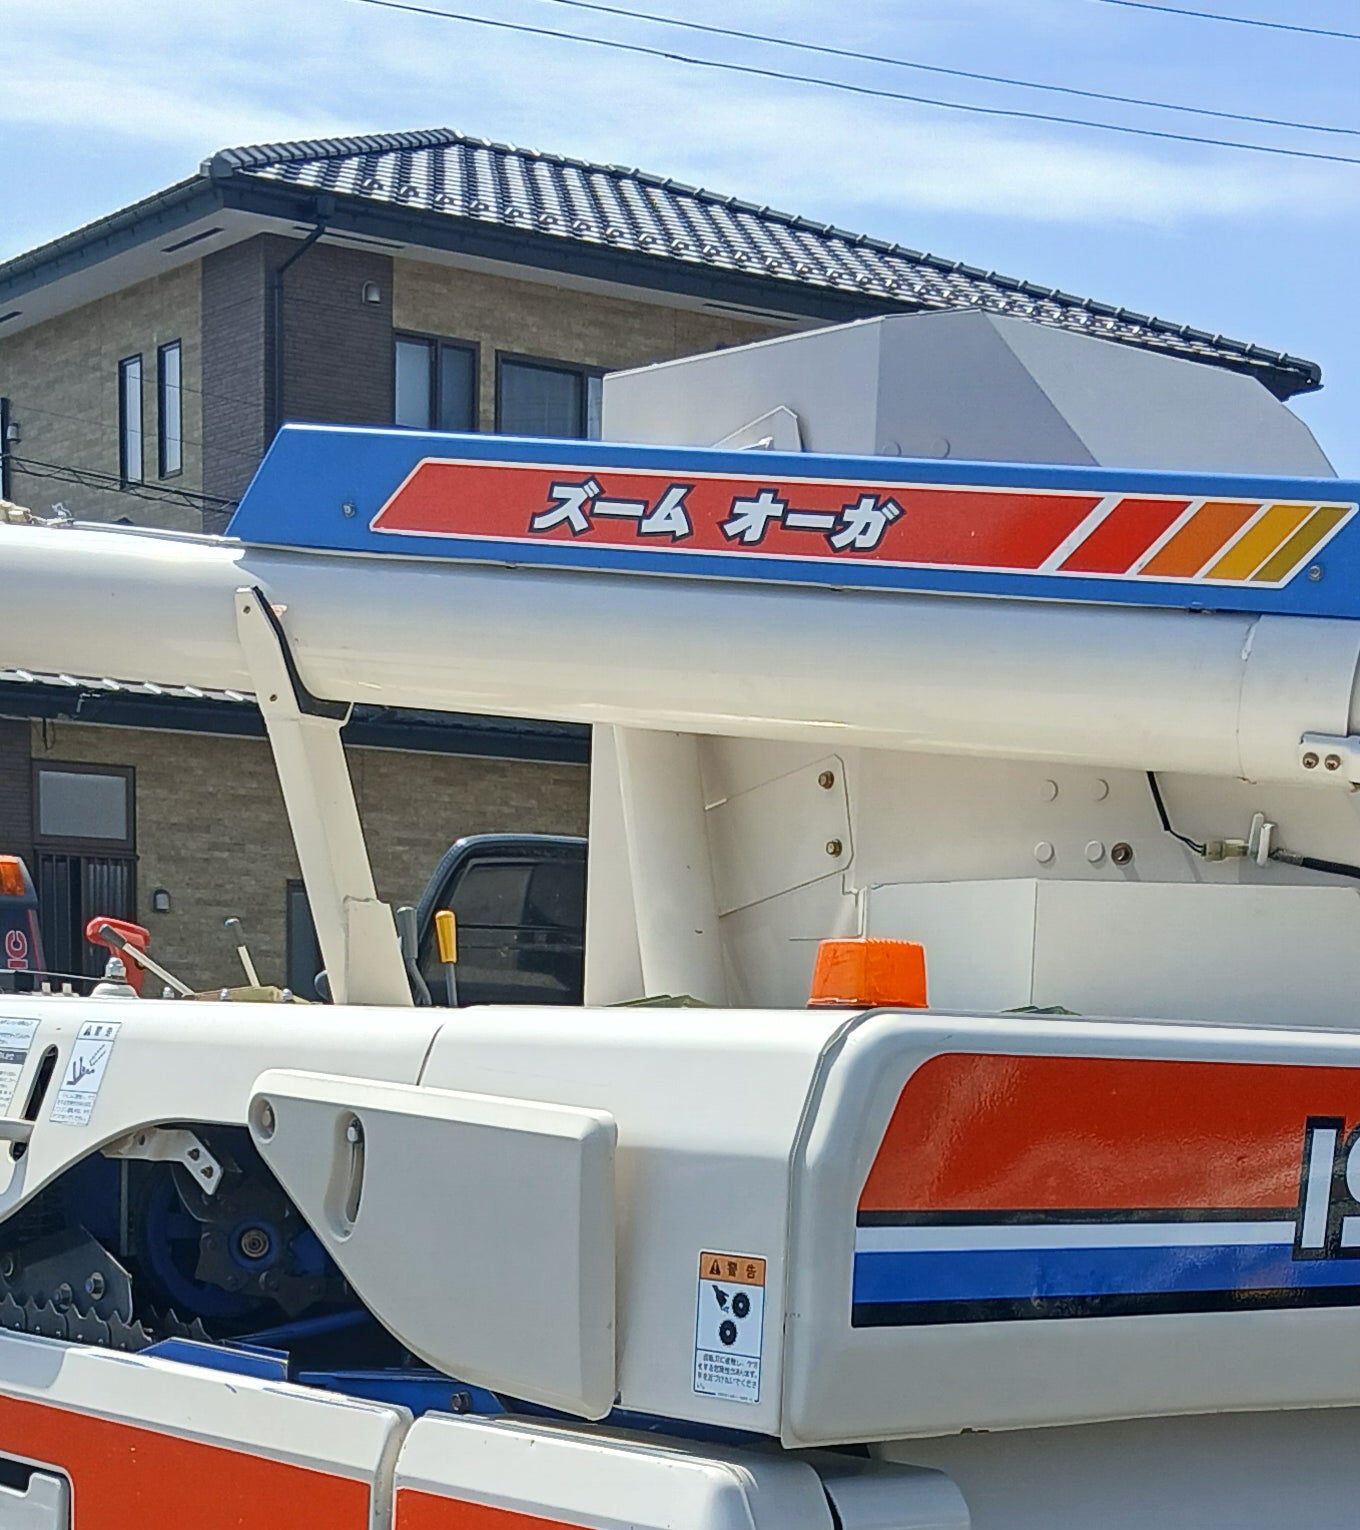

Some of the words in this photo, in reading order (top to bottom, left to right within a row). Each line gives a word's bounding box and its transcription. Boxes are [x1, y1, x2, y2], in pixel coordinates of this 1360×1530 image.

[532, 477, 692, 539] ズーム
[723, 489, 904, 555] オーガ
[727, 1260, 758, 1279] 警告
